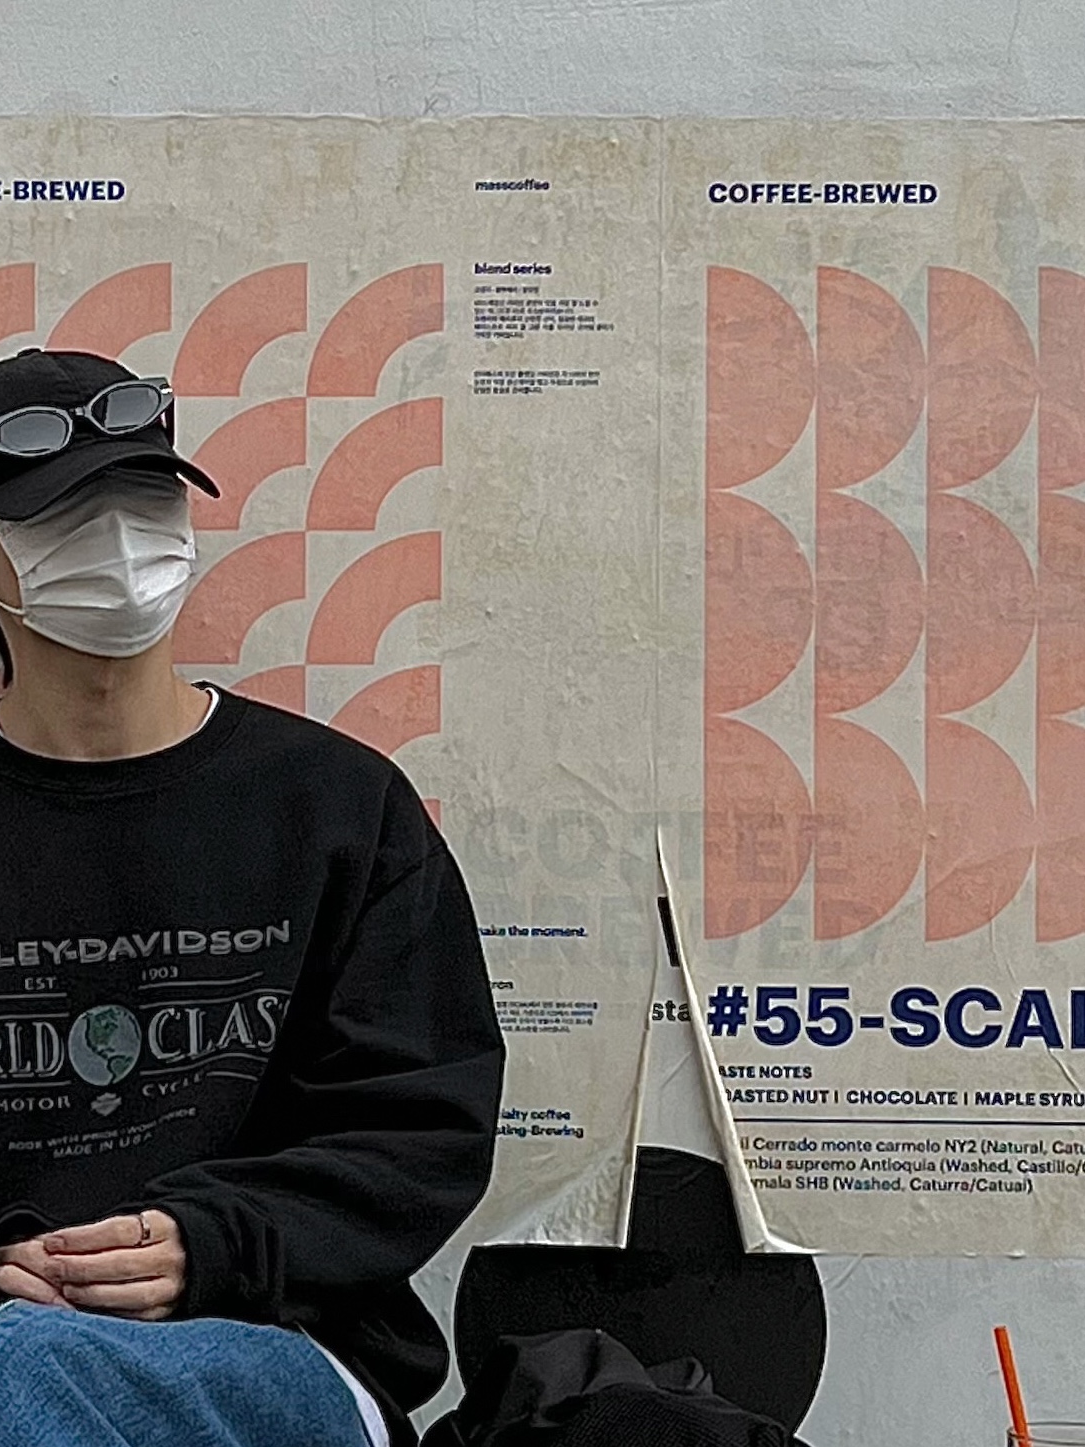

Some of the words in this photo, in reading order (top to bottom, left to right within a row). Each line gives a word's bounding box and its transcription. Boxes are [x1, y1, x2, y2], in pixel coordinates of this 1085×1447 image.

[708, 182, 938, 204] COFFEE-BREWED
[141, 965, 179, 981] 1903
[24, 976, 58, 991] EST
[147, 995, 291, 1064] CLAS
[718, 1065, 756, 1079] ASTE
[759, 1065, 813, 1079] NOTES
[726, 1088, 789, 1103] ASTED
[792, 1089, 830, 1104] NUT
[846, 1089, 958, 1106] CHOCOLATE
[975, 1091, 1036, 1107] MAPLE
[99, 1139, 114, 1152] IN
[753, 1137, 817, 1152] Cerrado
[821, 1139, 872, 1153] monte
[875, 1139, 940, 1154] carmelo
[944, 1139, 977, 1154] NY2
[785, 1158, 856, 1173] supremo
[860, 1157, 936, 1175] Antioquia
